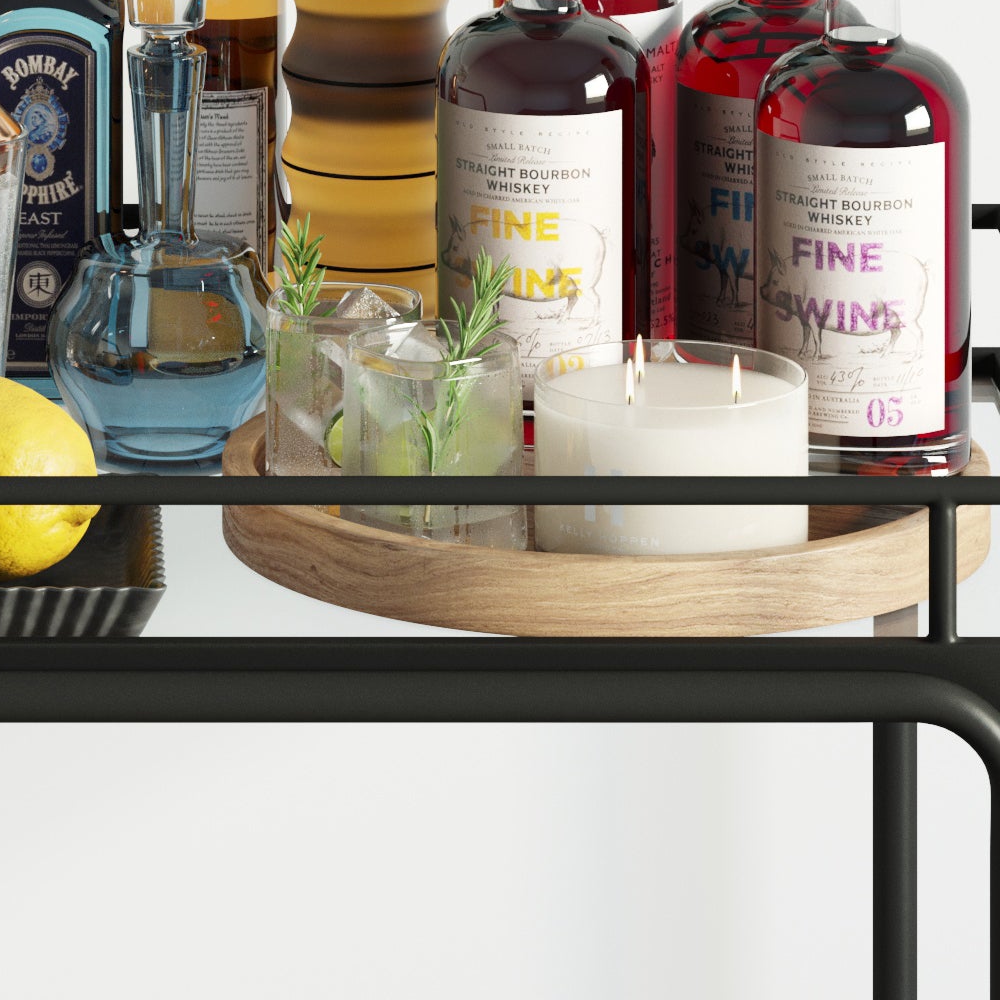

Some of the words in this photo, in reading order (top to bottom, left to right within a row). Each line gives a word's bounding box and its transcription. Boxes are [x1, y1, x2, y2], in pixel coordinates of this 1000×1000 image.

[646, 42, 676, 58] MALT
[1, 55, 79, 91] BOMBAY
[651, 64, 664, 73] ALT
[486, 143, 516, 151] SMALL
[518, 143, 552, 155] BATCH
[694, 141, 753, 160] STRAIGHT
[455, 157, 516, 179] STRAIGHT
[520, 168, 591, 180] BOURBON
[21, 170, 80, 205] PPHIRE
[486, 179, 550, 194] WHISKEY
[807, 174, 837, 182] SMALL
[840, 175, 873, 186] BATCH
[810, 184, 837, 195] Limited
[775, 190, 837, 210] STRAIGHT
[842, 198, 912, 212] BOURBON
[19, 212, 62, 225] EAST
[470, 204, 560, 241] FINE
[808, 211, 872, 226] WHISKEY
[792, 236, 884, 273] FINE
[28, 272, 55, 297] 東
[455, 255, 583, 299] SINE
[11, 313, 49, 321] IMPOR
[775, 290, 906, 333] SWINE
[830, 366, 865, 392] 43%
[866, 397, 904, 428] 05
